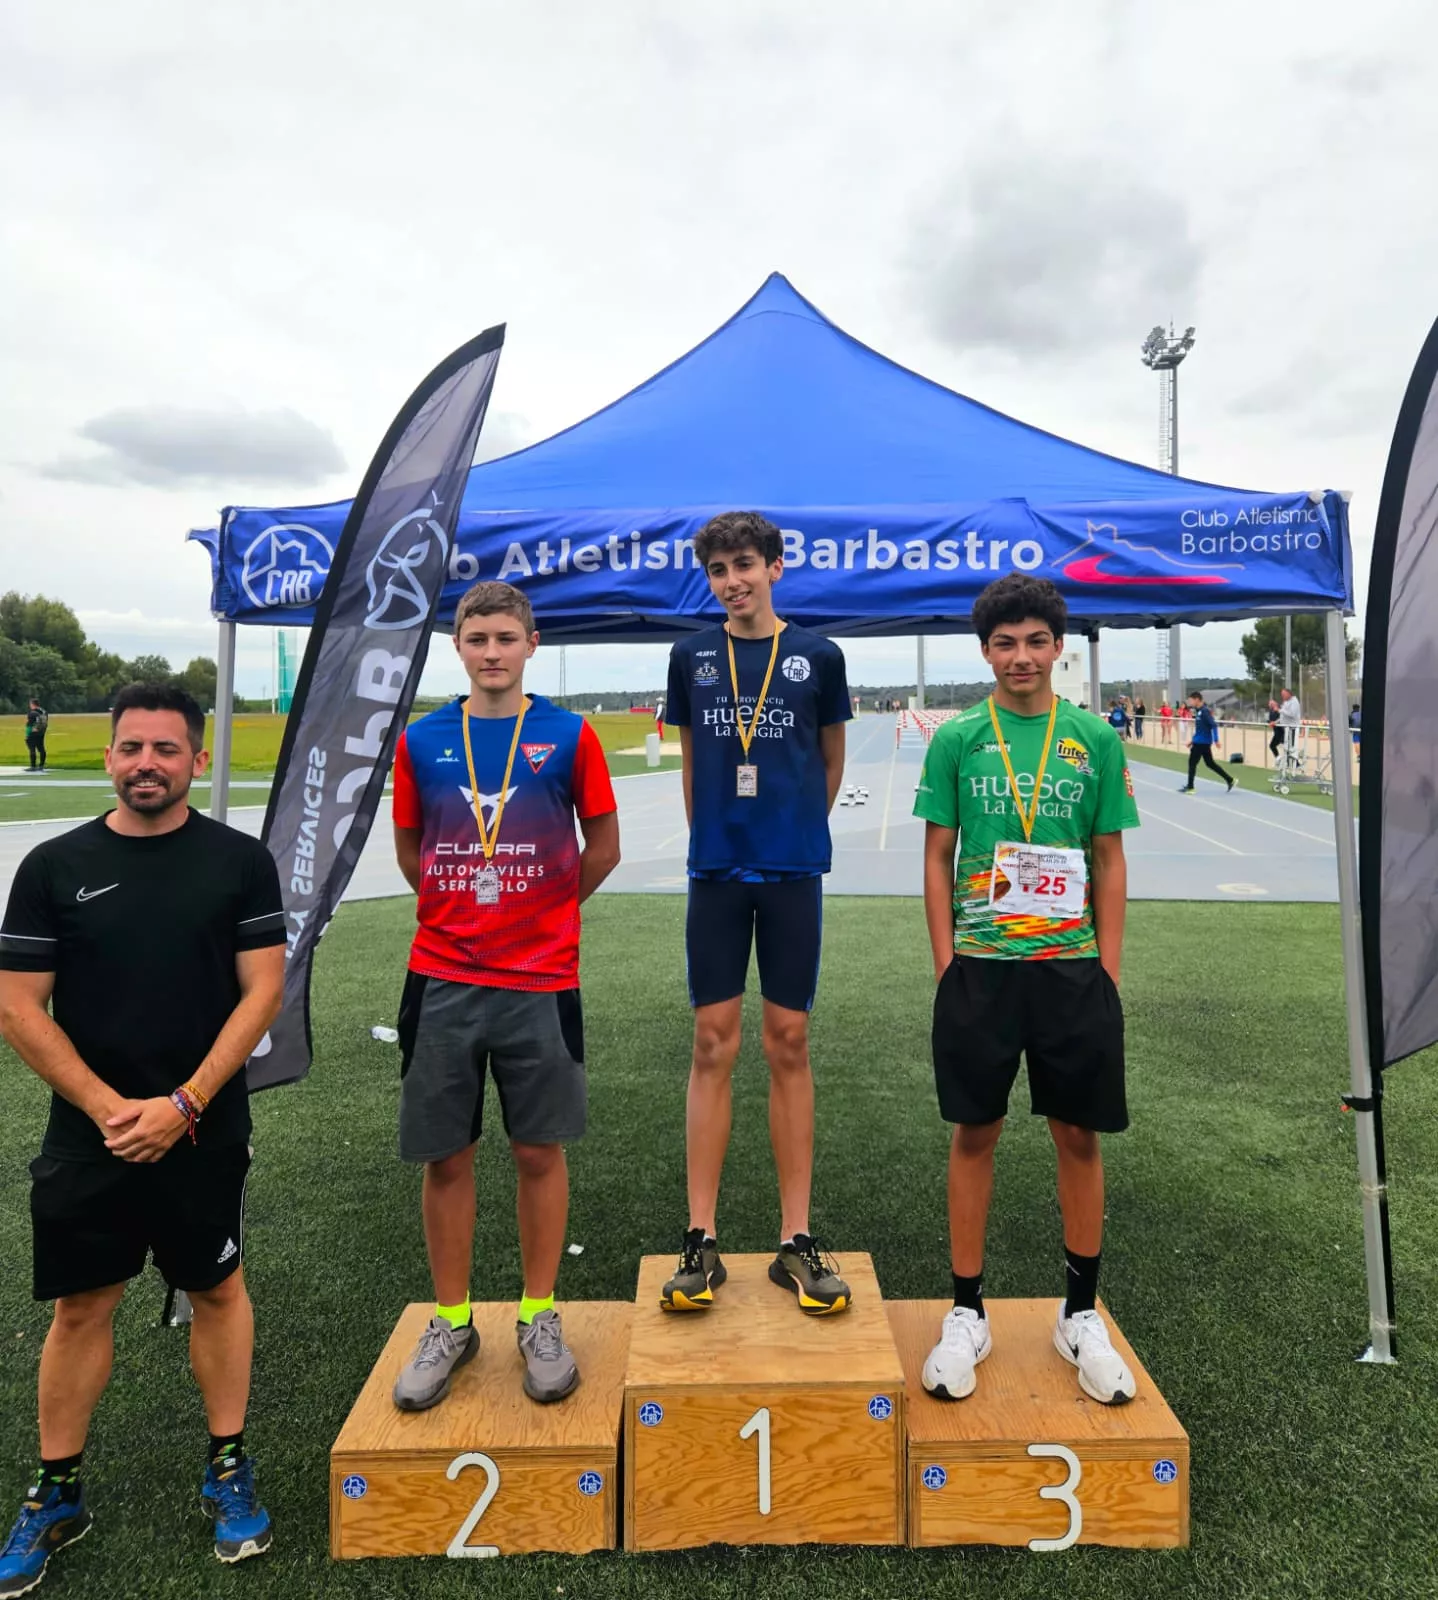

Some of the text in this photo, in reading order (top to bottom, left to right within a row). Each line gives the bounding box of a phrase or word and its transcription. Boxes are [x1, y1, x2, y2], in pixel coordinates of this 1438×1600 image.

[1181, 505, 1320, 528] Club Atletismo
[496, 530, 702, 580] Atletis
[779, 528, 1044, 571] Barbastro
[1181, 528, 1323, 555] Barbastro
[265, 569, 313, 605] CAB
[438, 880, 528, 892] SERRBLO
[739, 1407, 771, 1516] 1
[446, 1452, 500, 1559] 2
[1027, 1443, 1082, 1551] 3
